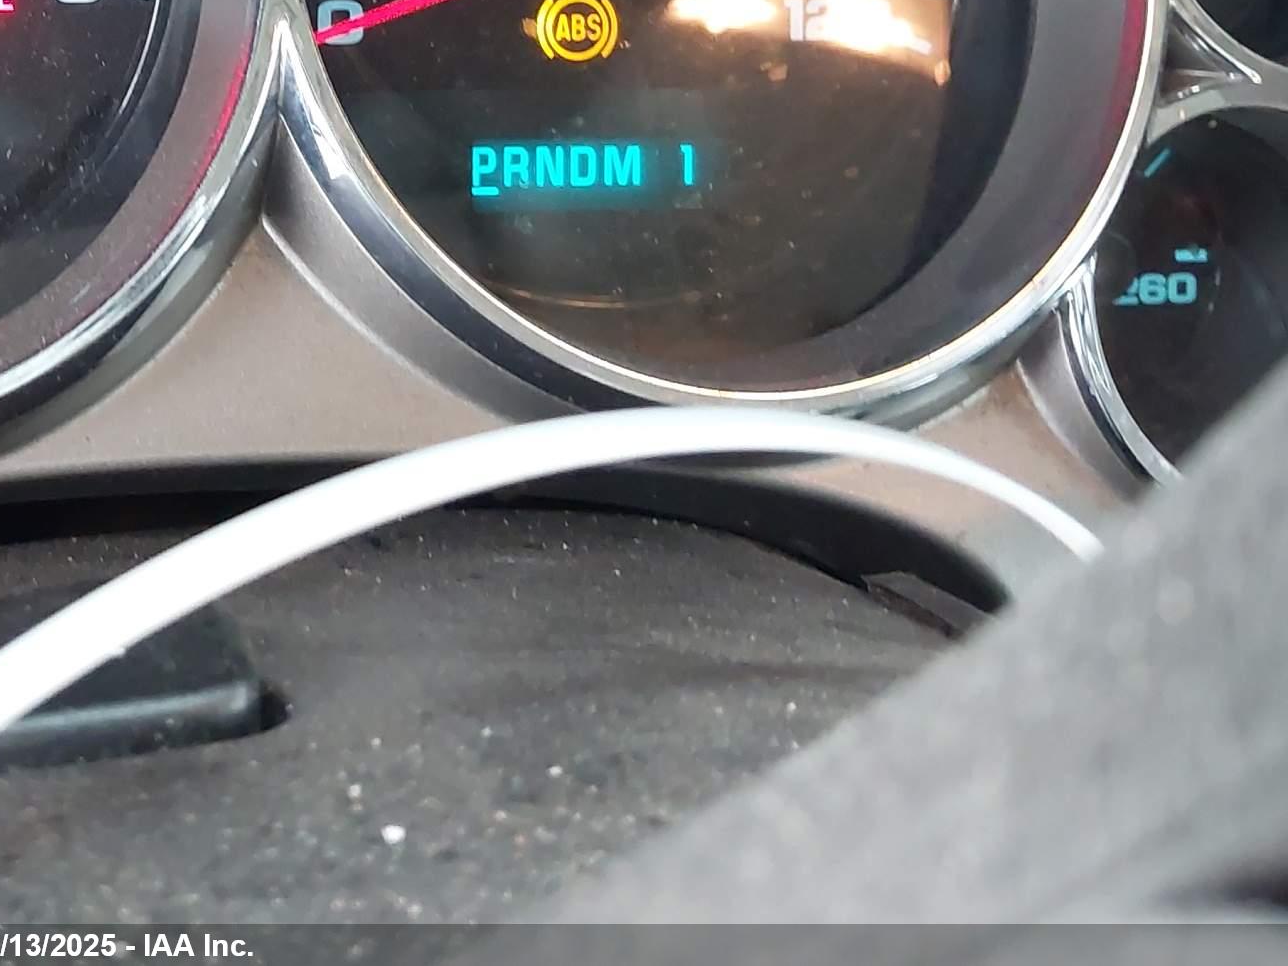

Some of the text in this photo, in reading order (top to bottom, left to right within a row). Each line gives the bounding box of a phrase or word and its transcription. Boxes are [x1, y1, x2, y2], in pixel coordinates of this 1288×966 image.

[317, 0, 363, 44] 0
[555, 12, 602, 41] ABS
[472, 145, 641, 188] PRNDM
